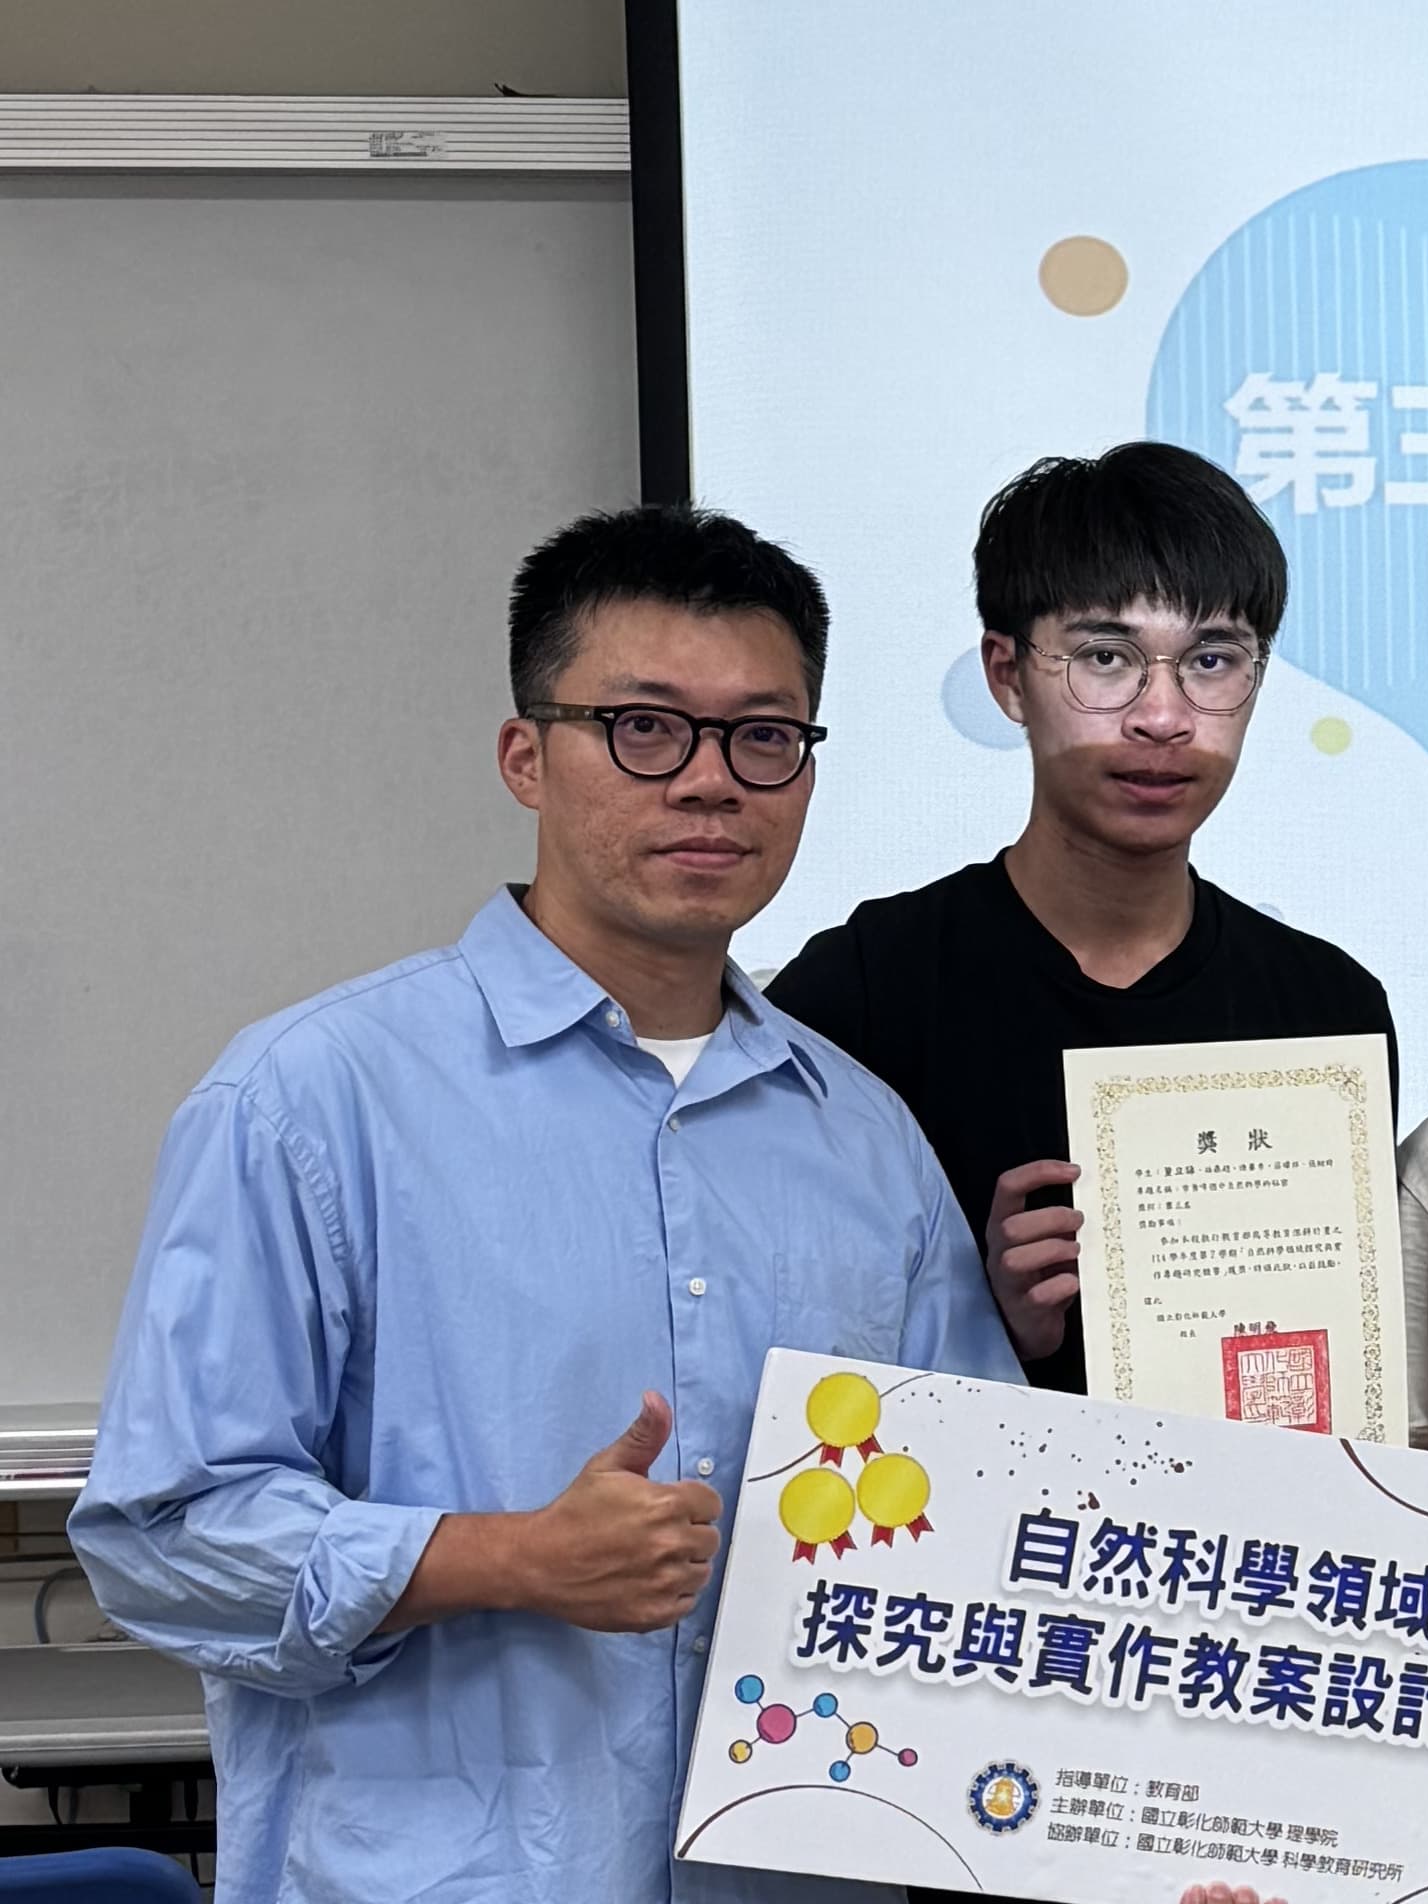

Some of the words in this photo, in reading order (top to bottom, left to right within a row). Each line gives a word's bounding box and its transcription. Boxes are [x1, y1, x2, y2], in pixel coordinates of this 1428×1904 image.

[1286, 1824, 1340, 1848] 理學院
[1281, 1850, 1405, 1883] 科學教育研究所
